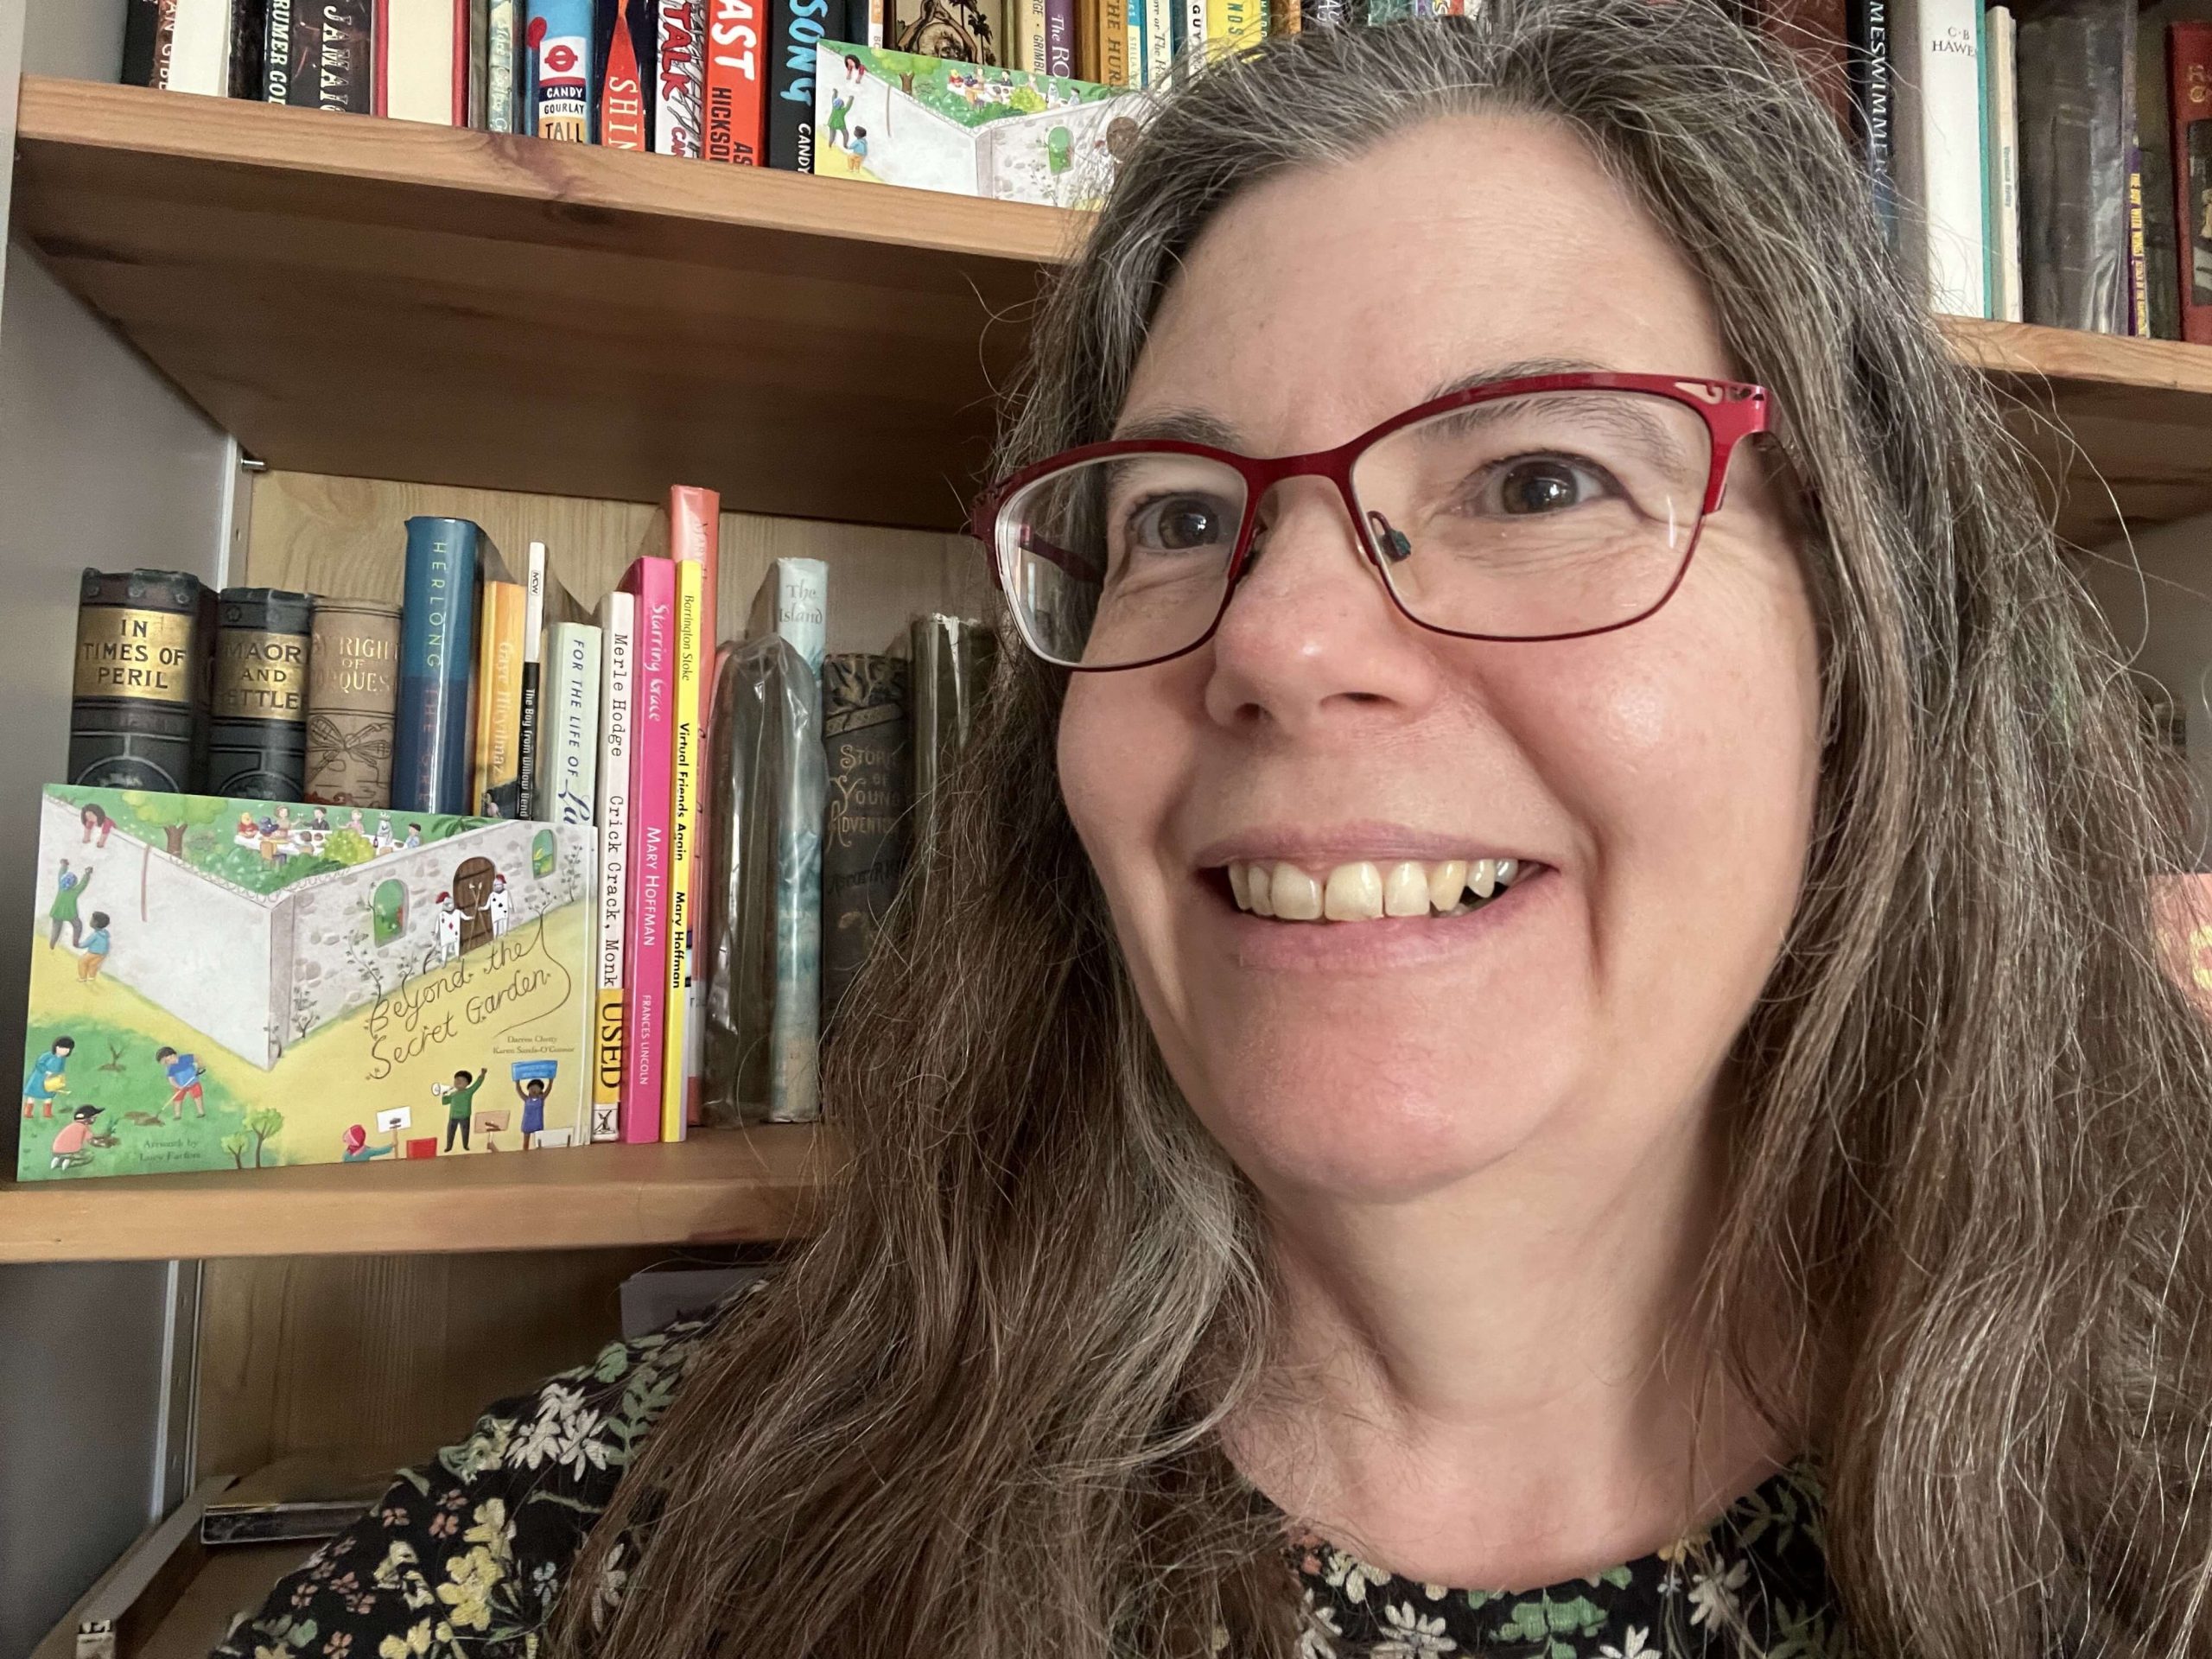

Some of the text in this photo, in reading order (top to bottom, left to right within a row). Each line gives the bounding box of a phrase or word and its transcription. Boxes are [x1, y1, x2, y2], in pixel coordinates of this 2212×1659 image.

[270, 0, 290, 66] RUMER
[1051, 13, 1065, 41] The
[1192, 4, 1202, 40] GUY
[660, 1, 693, 101] TALK
[779, 0, 828, 106] SONG
[544, 103, 584, 115] GOURLAY
[546, 86, 583, 99] CANDY
[545, 120, 583, 143] TALL
[797, 123, 811, 173] CANDY
[427, 541, 448, 668] HERLONG
[531, 571, 540, 595] MCW
[785, 579, 817, 601] The
[120, 619, 149, 639] IN
[779, 601, 823, 624] Island
[84, 642, 188, 666] TIMES OF
[572, 639, 584, 671] FOR
[681, 594, 695, 681] Barrington Stoke
[97, 666, 168, 690] PERIL
[240, 668, 288, 683] AND
[341, 658, 365, 670] OF
[644, 604, 671, 722] Starring Grace
[570, 680, 583, 709] THE
[607, 633, 628, 757] Merle Hodge
[519, 688, 536, 817] The Boy from Willow Bend
[569, 717, 581, 748] LIFE
[567, 756, 579, 777] OF
[674, 722, 690, 861] Virtual Friends Again
[604, 795, 624, 987] Crick Crack, Monk
[643, 826, 662, 947] MARY HOFFMAN
[671, 891, 685, 988] Mary Hoffman
[369, 940, 527, 1038] Beyond the
[366, 968, 550, 1080] Secret Garden
[600, 1002, 623, 1089] USED
[639, 995, 652, 1085] FRANCES LINCOLN
